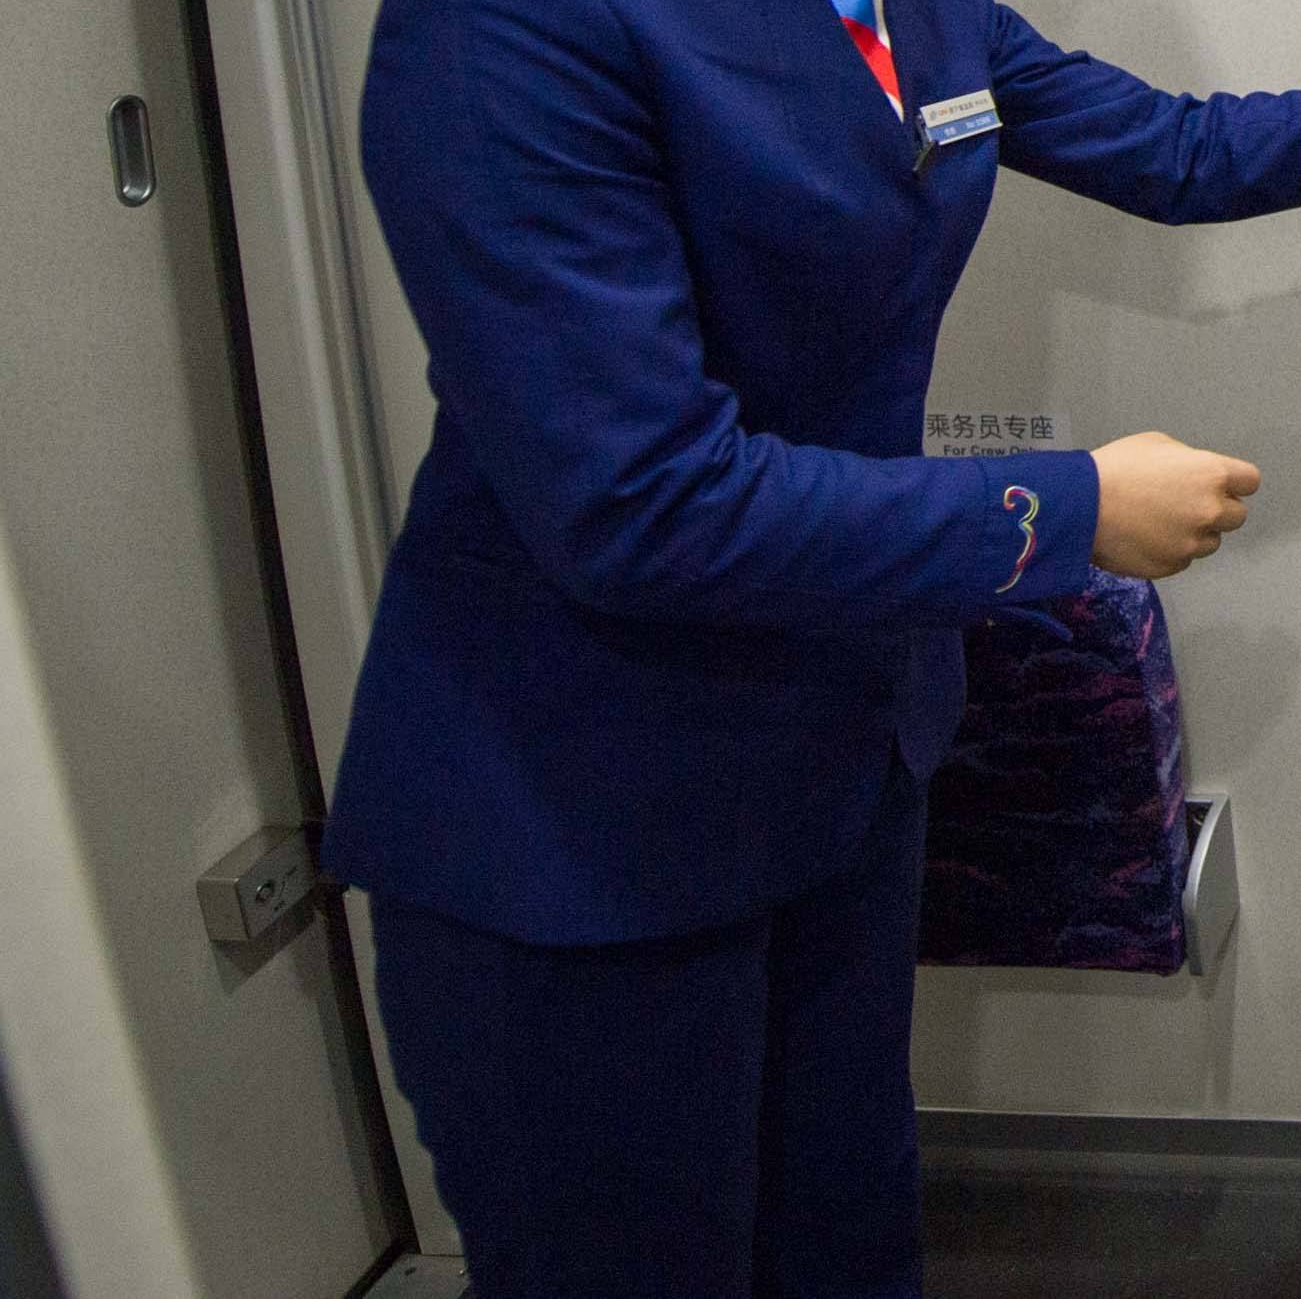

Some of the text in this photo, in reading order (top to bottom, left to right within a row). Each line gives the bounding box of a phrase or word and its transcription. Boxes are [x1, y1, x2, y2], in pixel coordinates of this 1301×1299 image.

[927, 413, 1055, 440] 乘务员专座
[943, 445, 965, 455] For
[970, 445, 1006, 455] Crew
